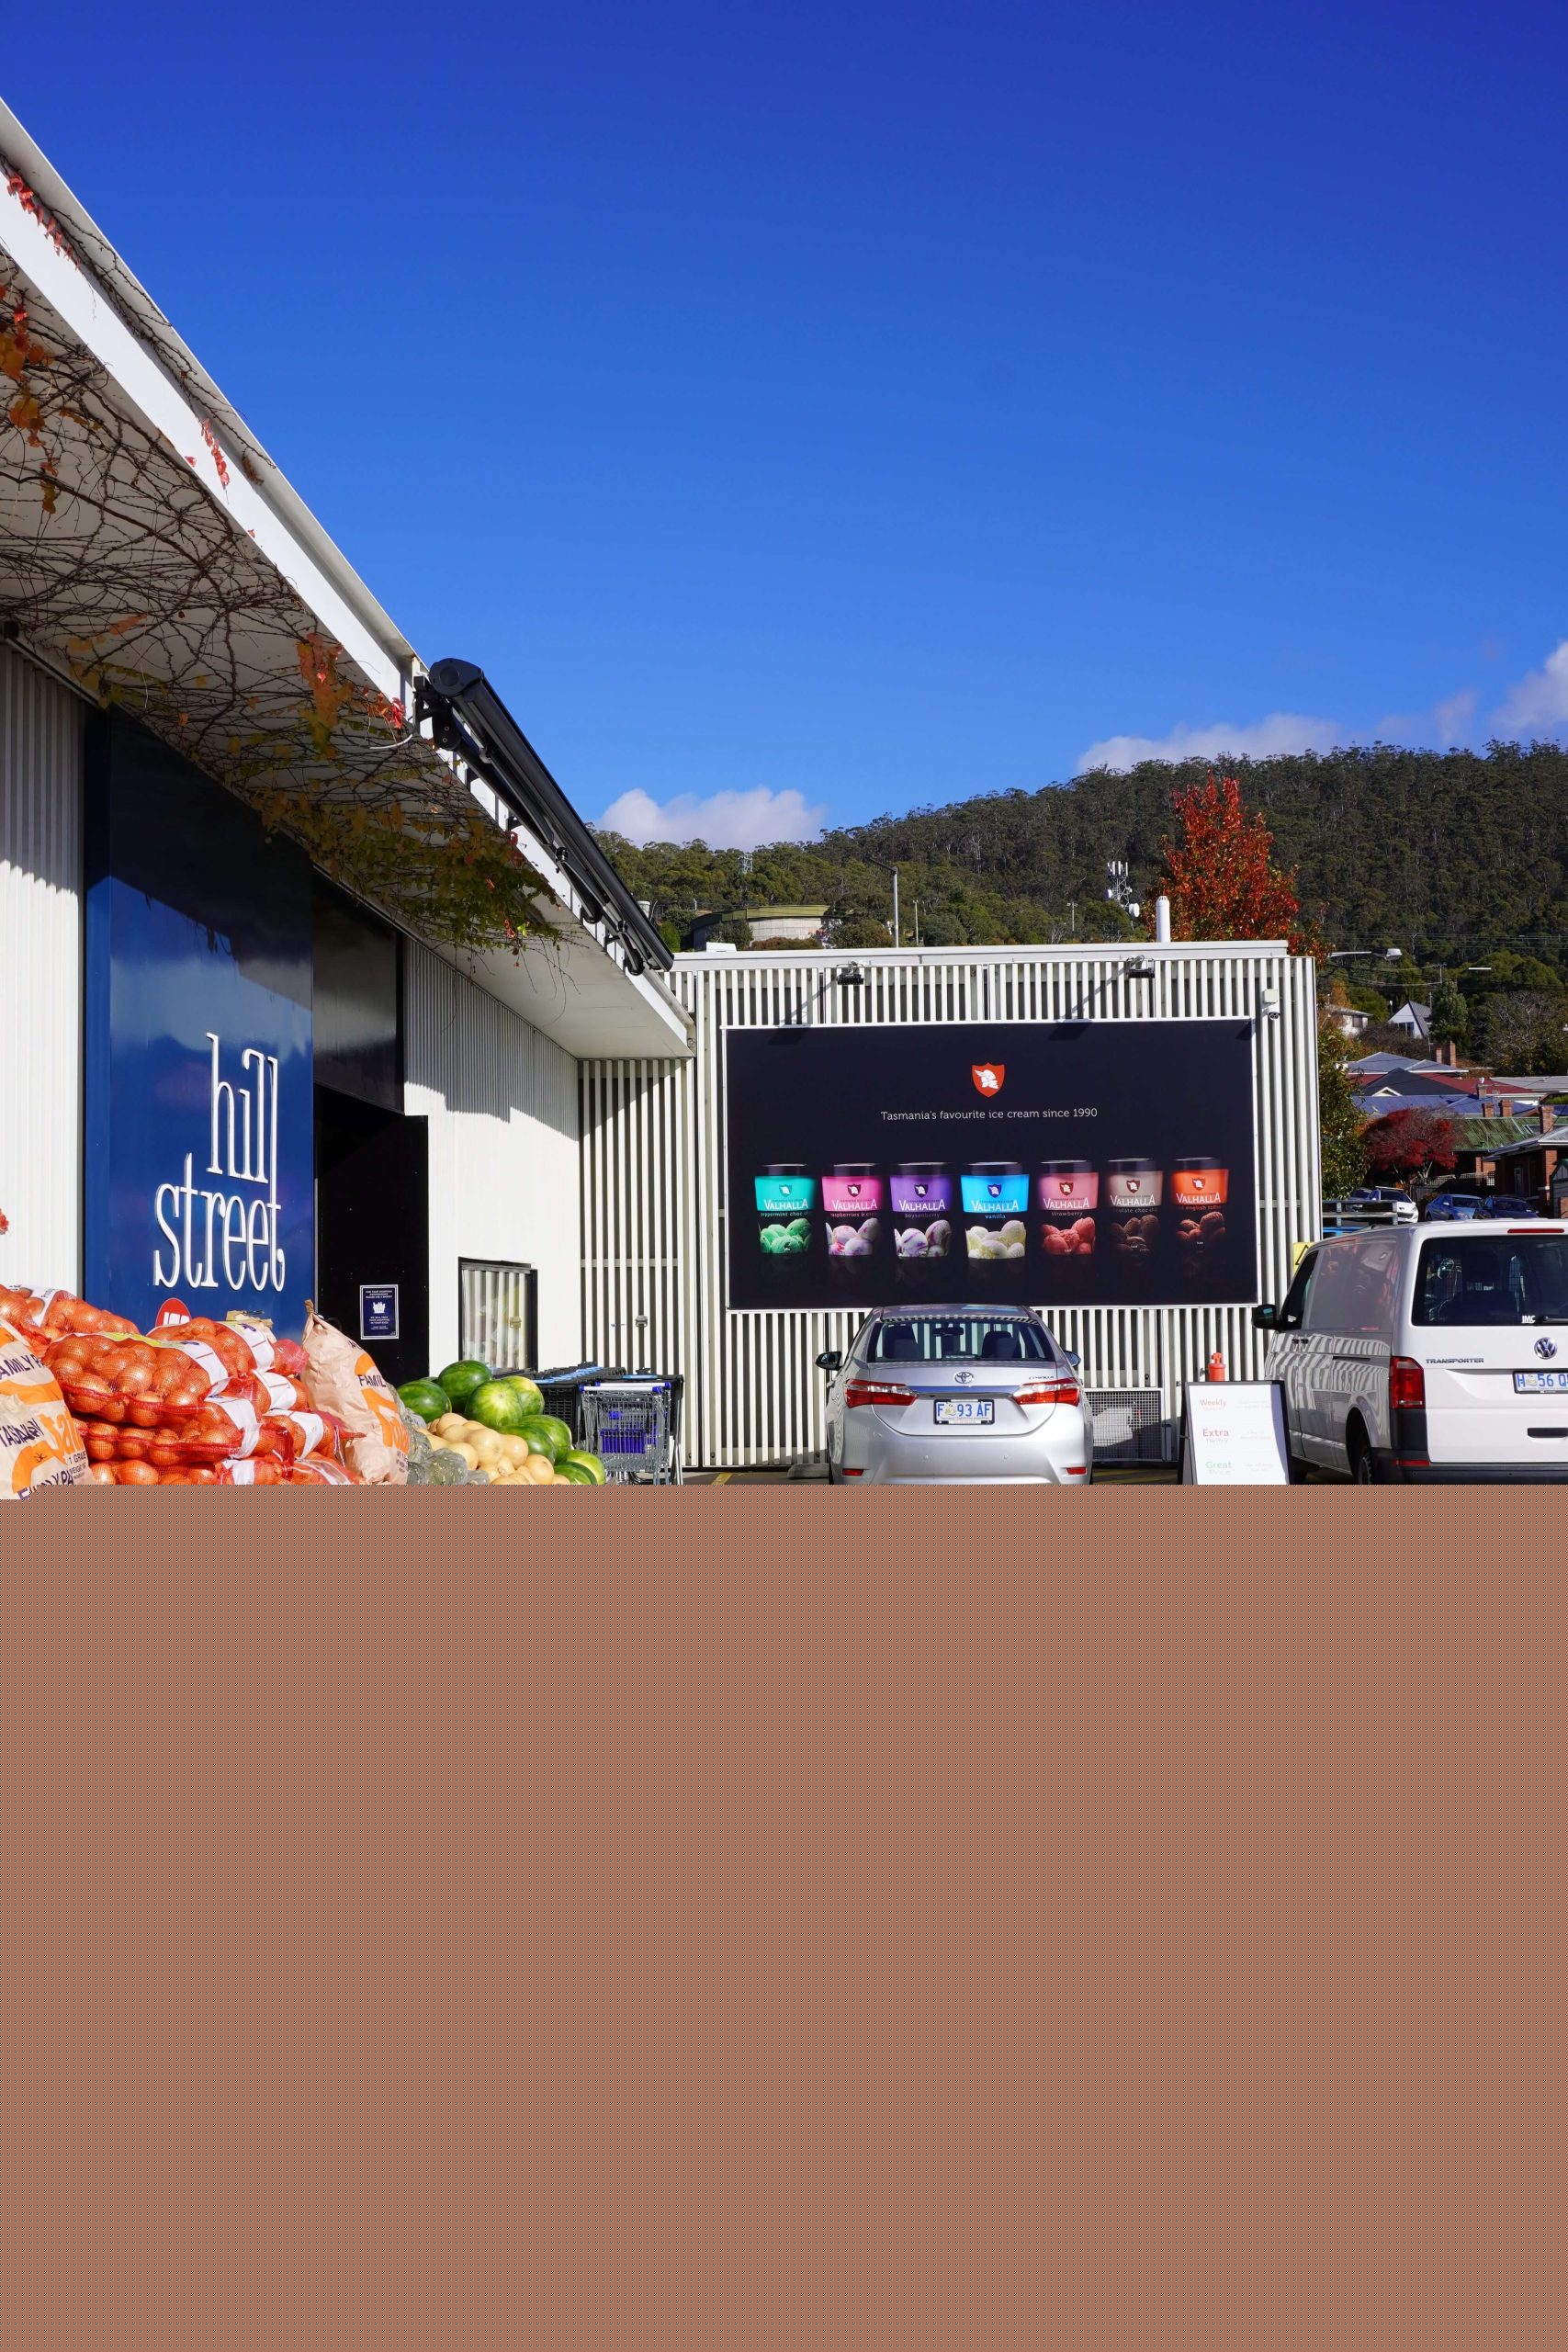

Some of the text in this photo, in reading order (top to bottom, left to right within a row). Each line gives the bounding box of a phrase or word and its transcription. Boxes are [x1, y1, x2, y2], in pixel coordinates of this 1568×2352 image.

[206, 1032, 277, 1183] hill
[881, 1107, 1098, 1121] Tasmania's favourite ice cream since 1990
[764, 1198, 808, 1210] VALHALLA
[831, 1198, 877, 1210] VALHALLA
[898, 1198, 946, 1211] VALHALLA
[1043, 1196, 1090, 1209] VALHALLA
[1110, 1193, 1156, 1206] VALHALLA
[1176, 1192, 1222, 1204] VALHALLA
[971, 1199, 1020, 1212] VALHALLA
[153, 1152, 286, 1293] street
[357, 1374, 387, 1387] FAMIL
[1537, 1373, 1554, 1387] 56
[1558, 1374, 1568, 1387] Q
[1200, 1397, 1227, 1407] Weekly
[937, 1401, 992, 1417] F 93 AF
[1202, 1428, 1229, 1437] Extra
[1205, 1461, 1232, 1469] Great
